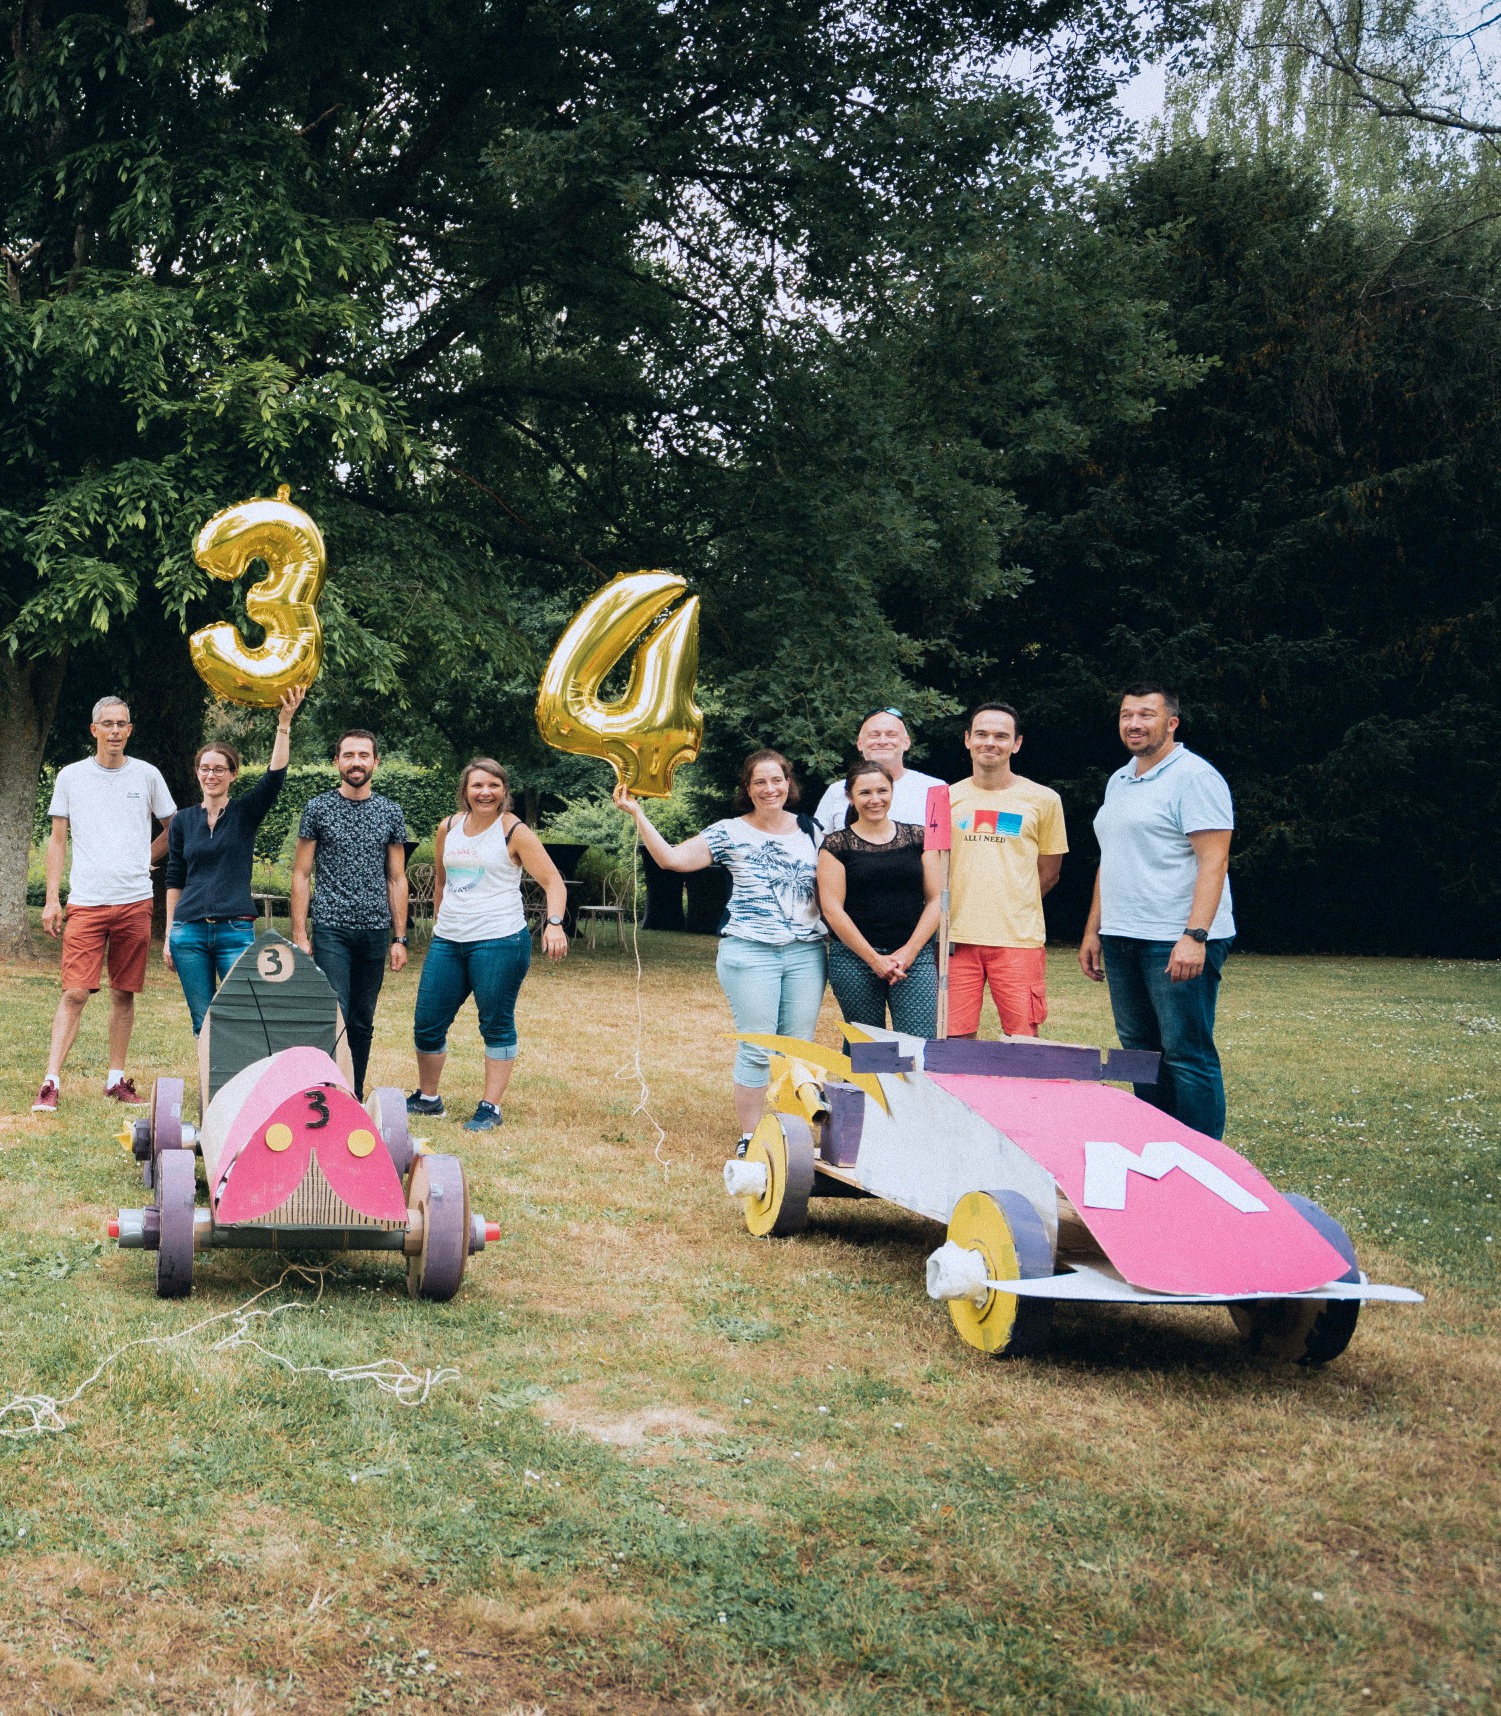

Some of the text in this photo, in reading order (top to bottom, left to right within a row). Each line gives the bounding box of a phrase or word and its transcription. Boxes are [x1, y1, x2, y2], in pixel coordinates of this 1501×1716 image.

[189, 484, 327, 708] 3
[534, 569, 704, 799] 4
[930, 802, 938, 833] 4
[983, 835, 1006, 844] NEED
[264, 948, 283, 976] 3
[304, 1090, 330, 1129] 3
[1083, 1141, 1271, 1213] M
